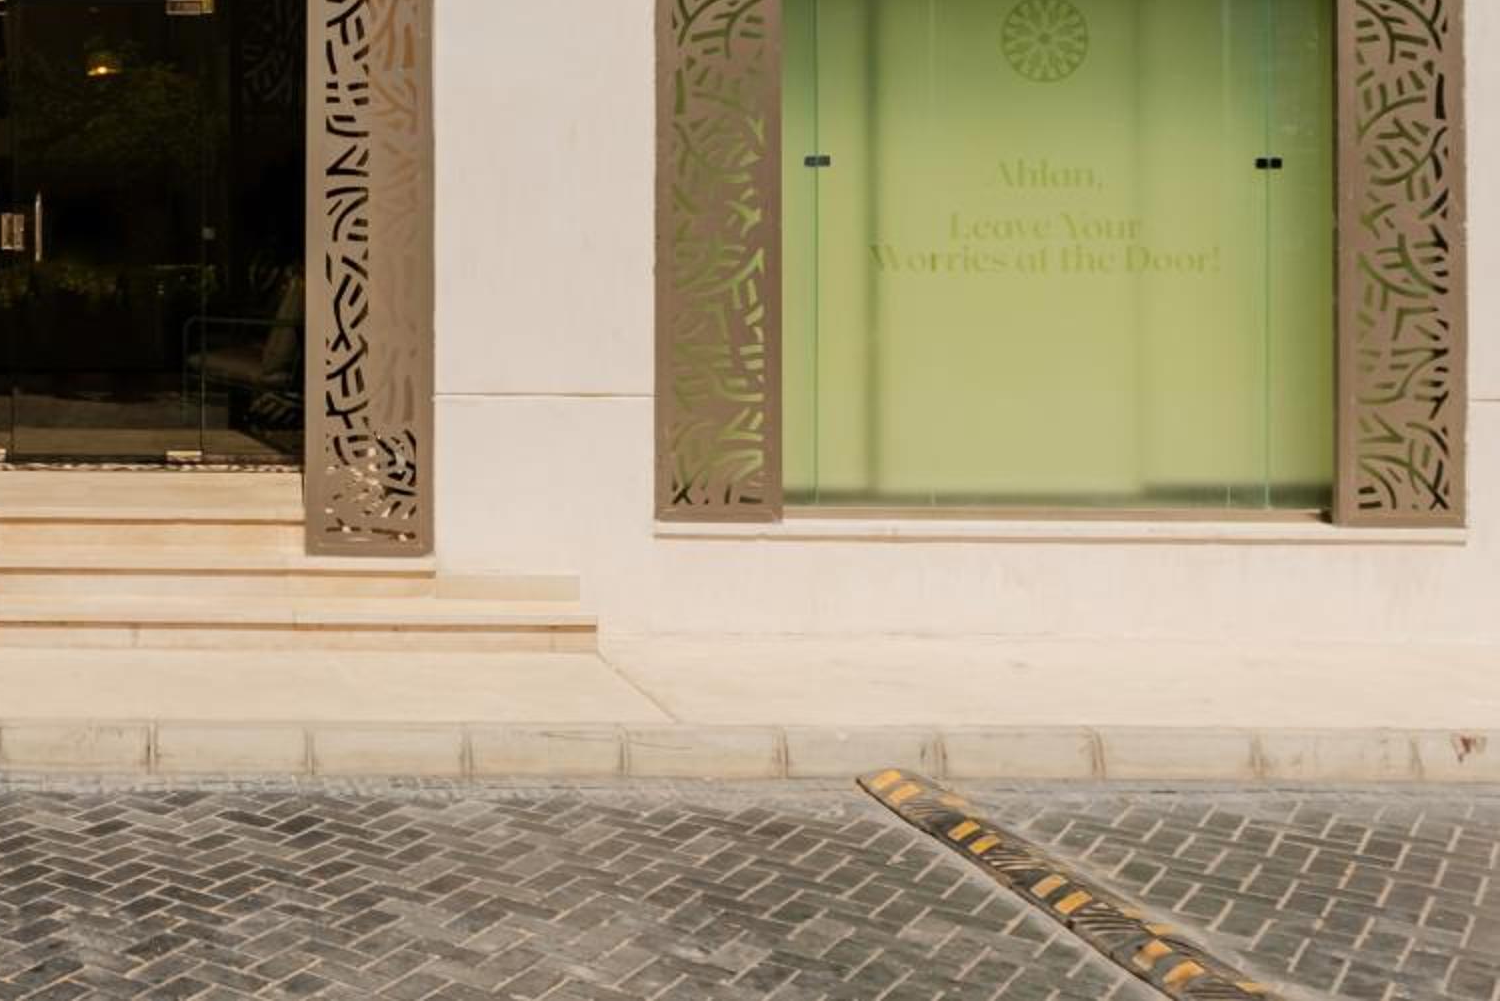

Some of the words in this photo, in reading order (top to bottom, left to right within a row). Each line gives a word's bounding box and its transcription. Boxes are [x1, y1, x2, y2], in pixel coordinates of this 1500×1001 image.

[949, 212, 1051, 241] Leave
[1060, 213, 1143, 241] Your
[869, 244, 1009, 275] Worries
[1016, 246, 1049, 275] at
[1057, 246, 1116, 275] the
[1124, 247, 1221, 275] Door!
